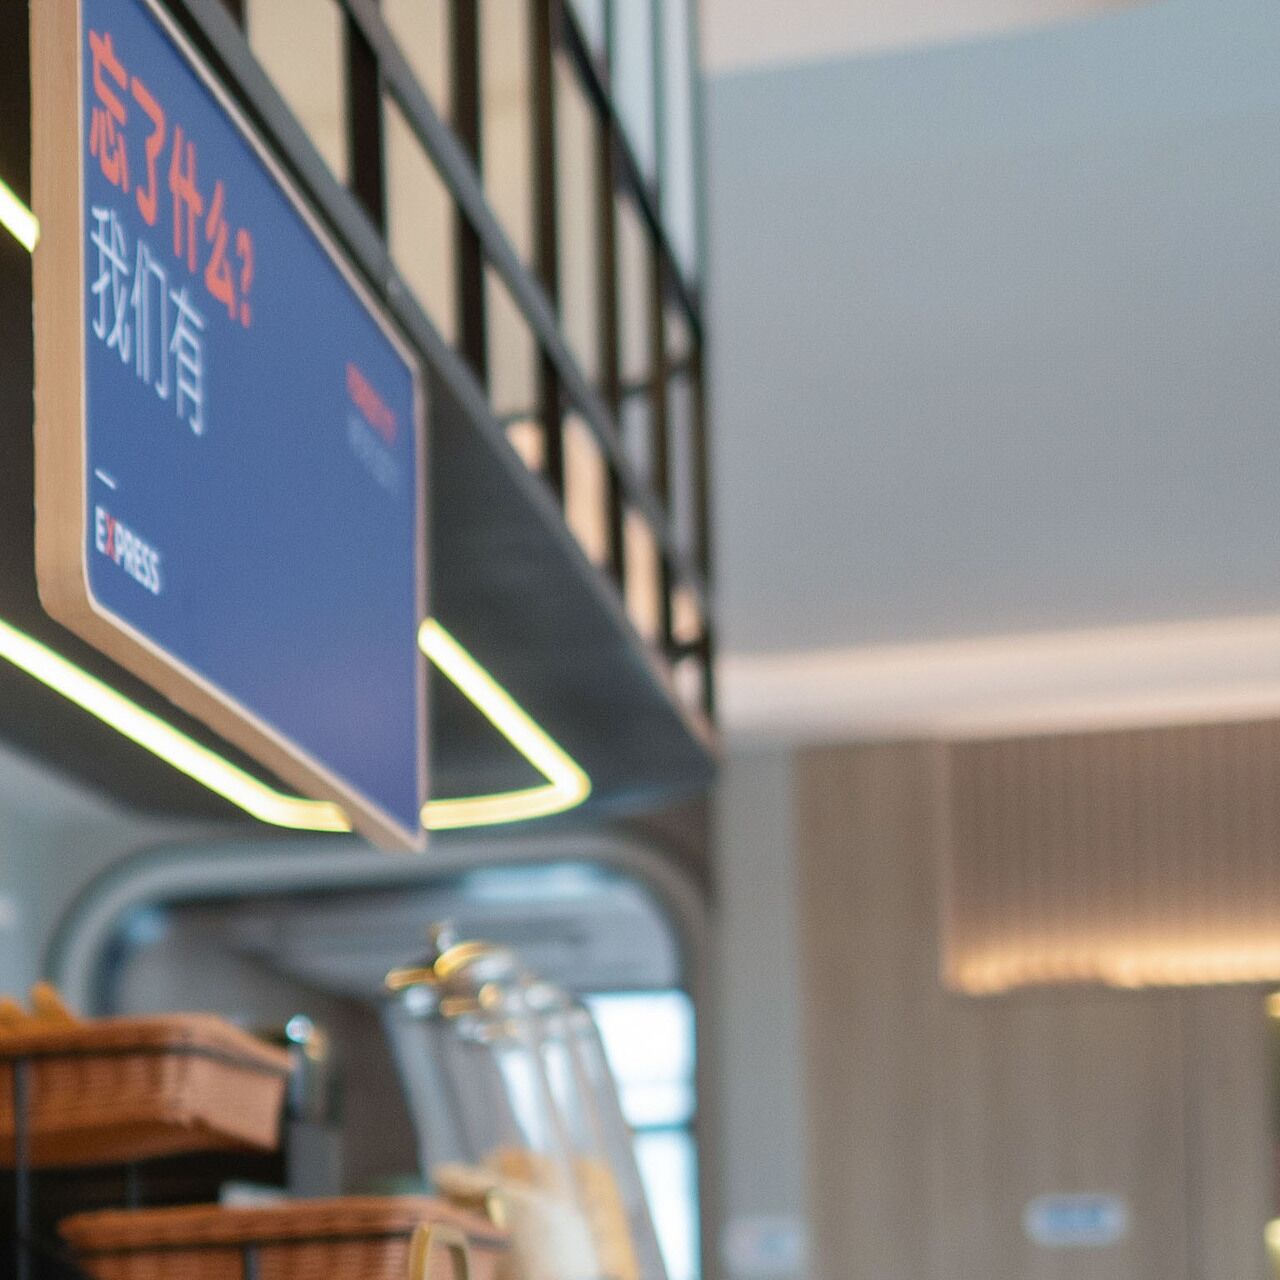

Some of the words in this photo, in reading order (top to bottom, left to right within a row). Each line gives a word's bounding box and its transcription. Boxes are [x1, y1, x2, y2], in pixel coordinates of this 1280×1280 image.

[89, 30, 255, 328] 忘了什么?
[91, 206, 204, 437] 我们有
[95, 505, 160, 594] EXPRESS
